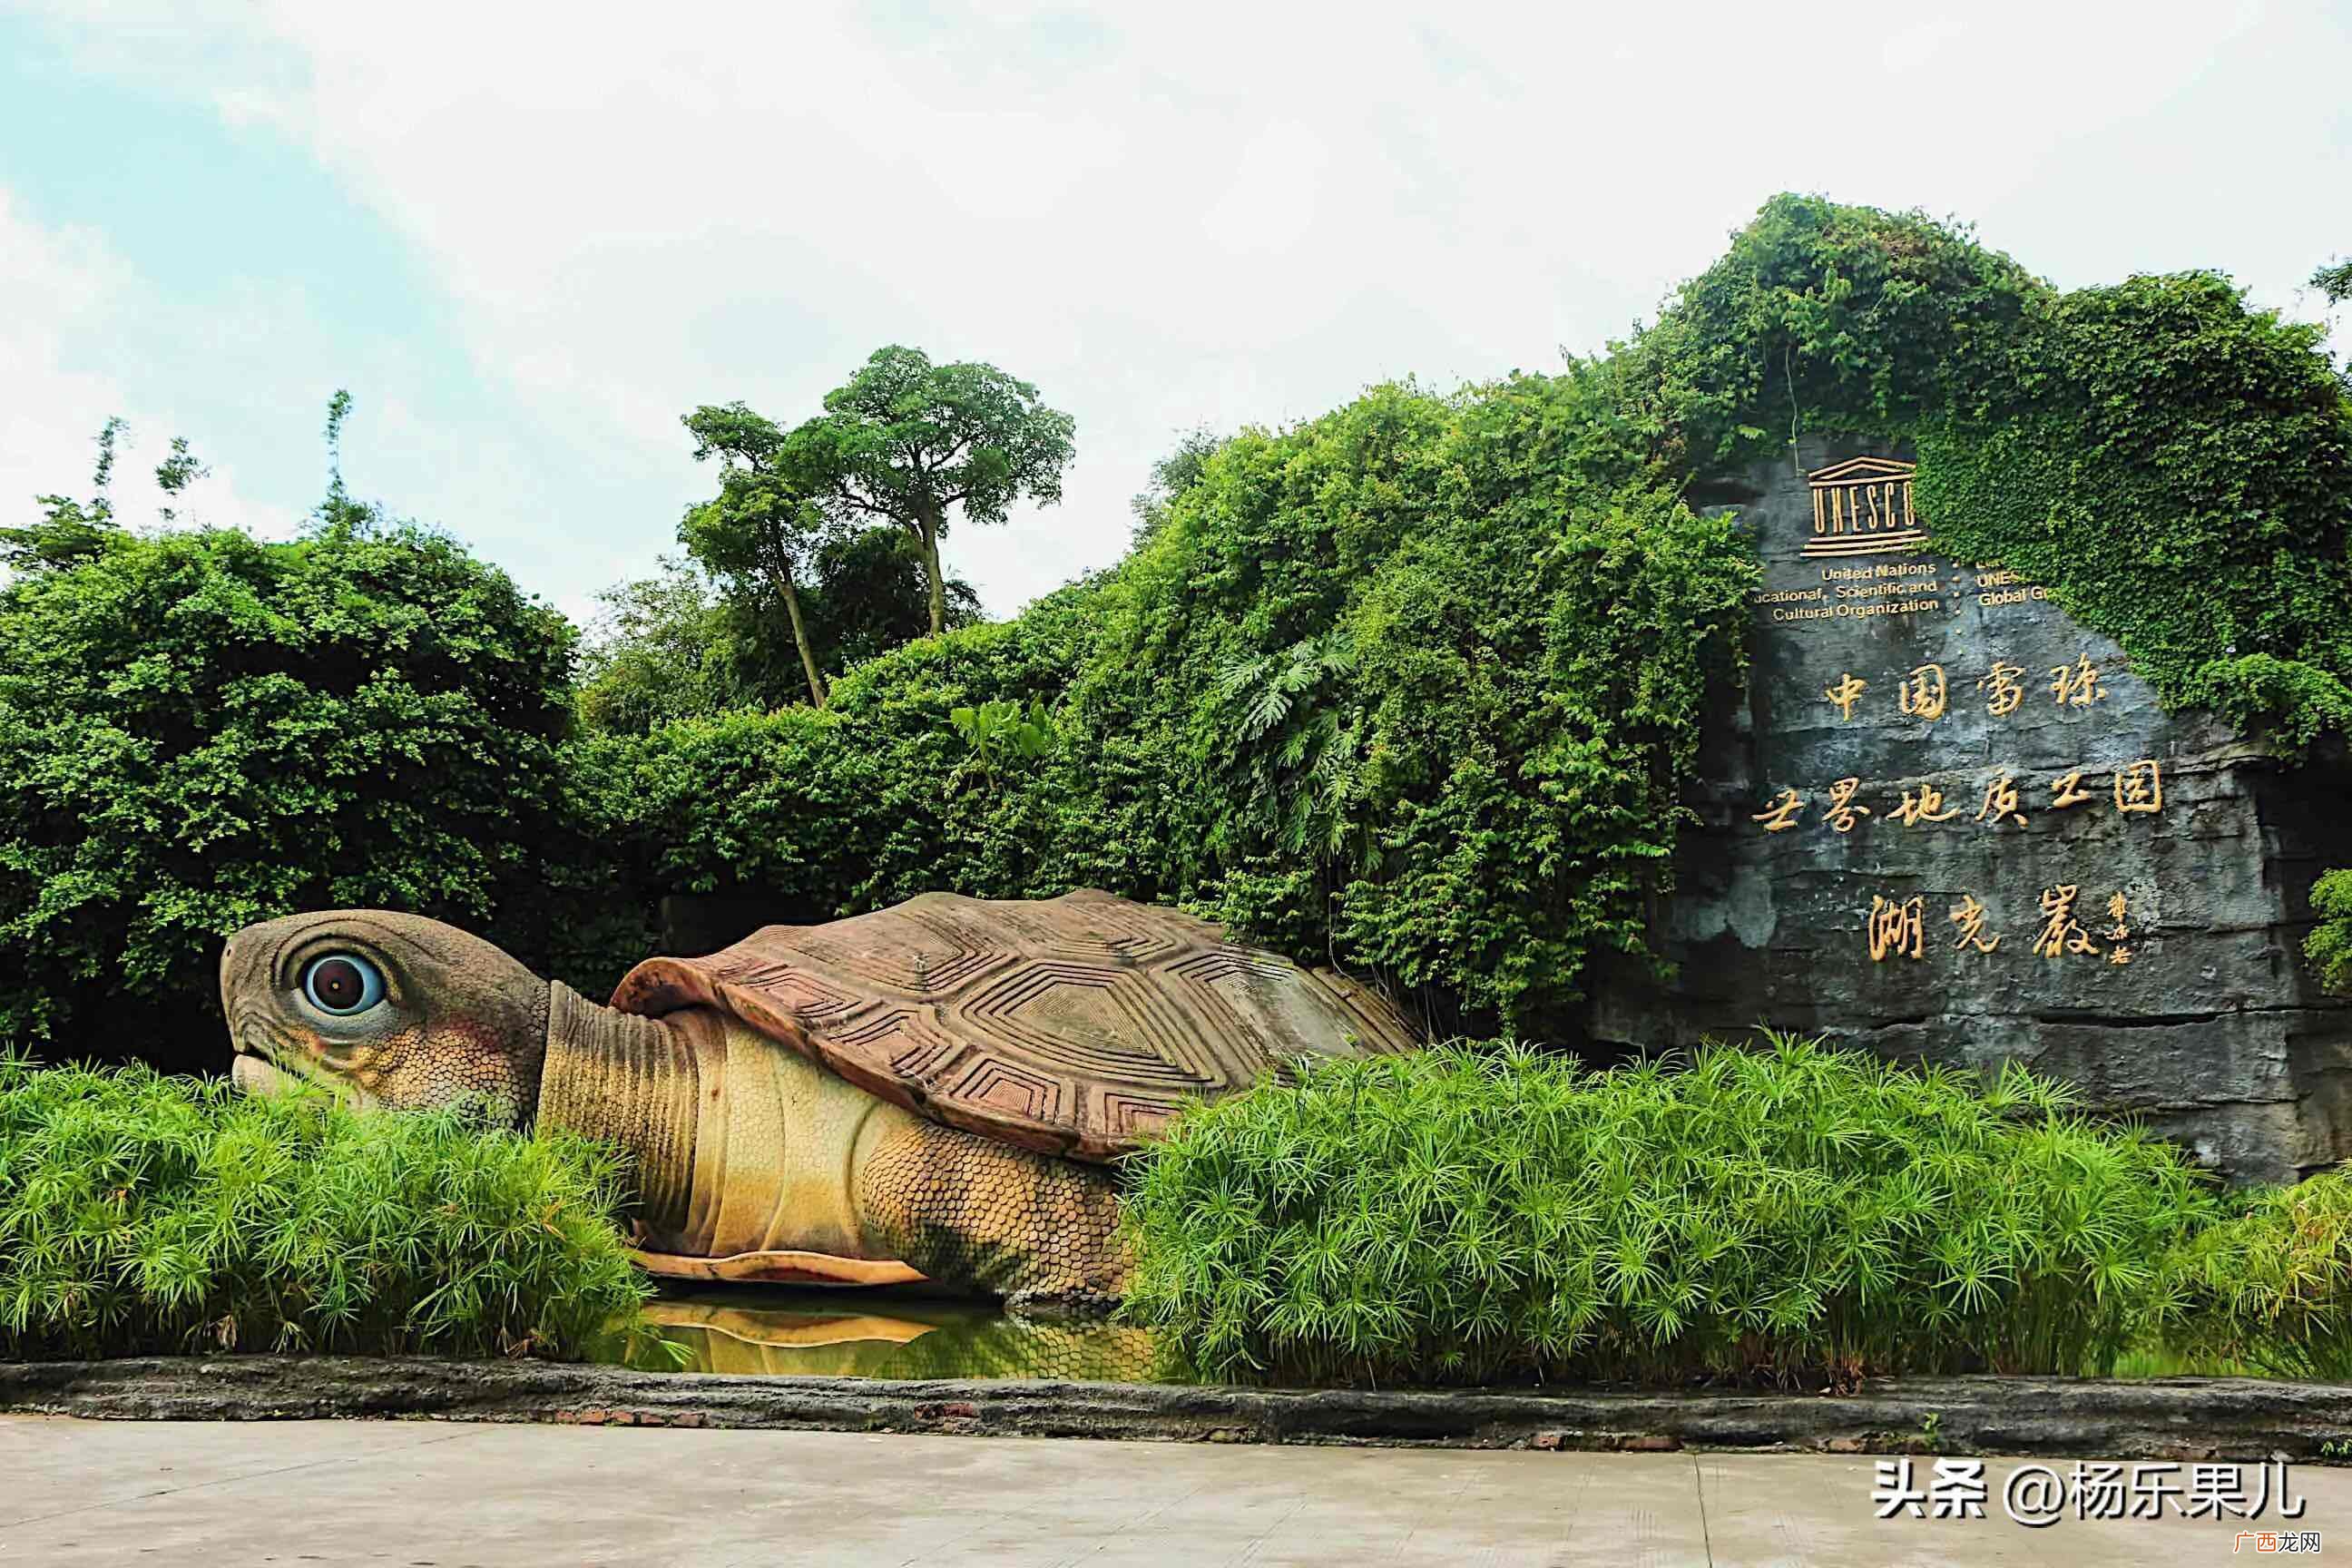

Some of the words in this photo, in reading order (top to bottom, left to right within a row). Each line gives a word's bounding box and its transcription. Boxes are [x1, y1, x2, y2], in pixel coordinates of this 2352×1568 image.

[1813, 480, 1916, 534] UNESCO
[1821, 568, 1873, 582] United
[1875, 563, 1937, 576] Nations
[1751, 586, 1829, 605] ucational,
[1836, 583, 1906, 599] Scientific
[1907, 581, 1937, 594] and
[1979, 588, 2027, 606] Global
[1772, 606, 1833, 622] Cultural
[1837, 599, 1939, 619] Organization
[1751, 760, 2162, 833] 世界地质公园
